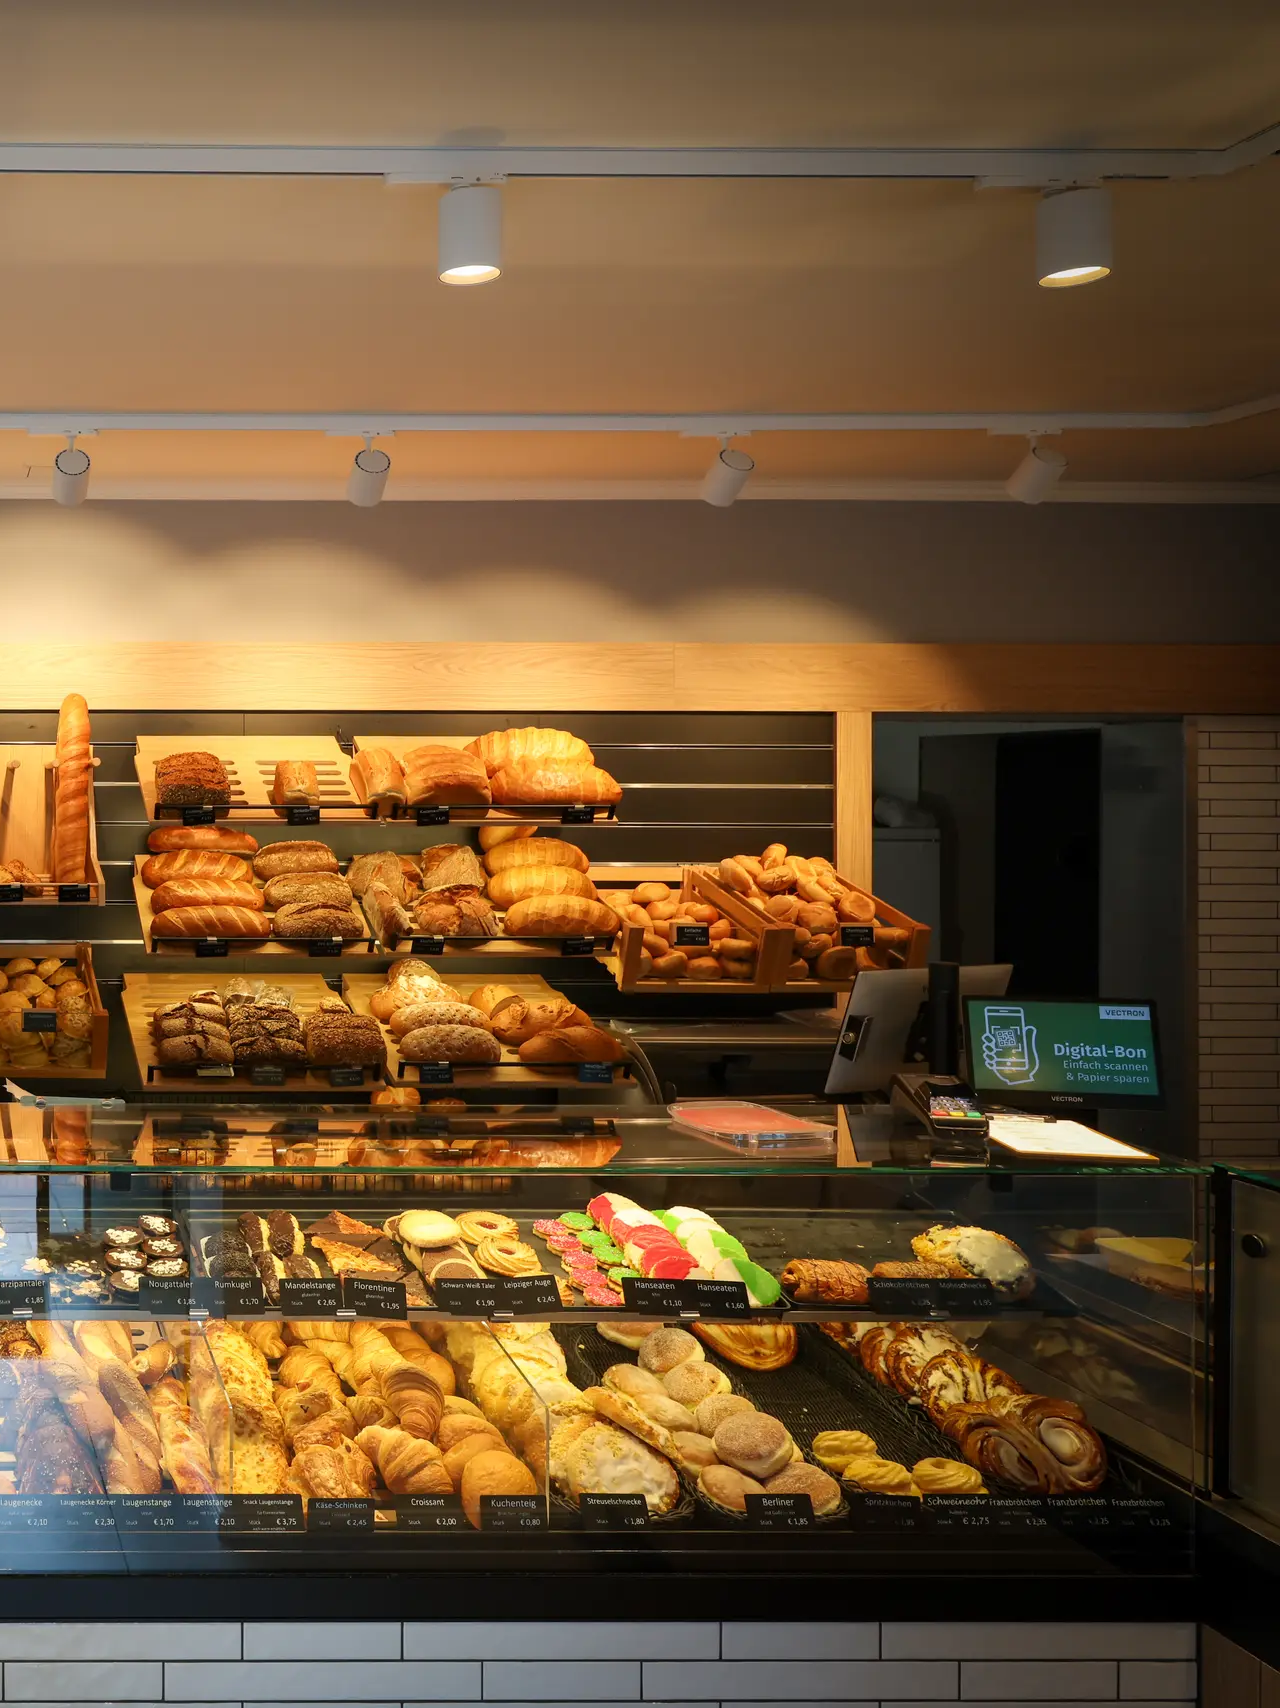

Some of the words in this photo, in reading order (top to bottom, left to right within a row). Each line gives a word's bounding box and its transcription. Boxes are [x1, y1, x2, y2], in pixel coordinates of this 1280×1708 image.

[1104, 1009, 1146, 1018] VECTRON
[1053, 1042, 1148, 1061] Digital-Bon
[1063, 1060, 1102, 1071] Einfach
[1103, 1062, 1149, 1072] scannen
[1065, 1072, 1075, 1082] &
[1077, 1072, 1112, 1085] Papier
[1113, 1075, 1150, 1086] sparen
[1051, 1095, 1084, 1103] VECTRON
[149, 1281, 193, 1289] Nougattaler
[214, 1281, 252, 1289] Rumkugel
[285, 1282, 336, 1290] Mandelstange
[353, 1282, 396, 1293] Florentiner
[503, 1281, 533, 1289] Leipziger
[534, 1279, 552, 1287] Auge
[634, 1281, 675, 1290] Hanseaten
[697, 1283, 737, 1292] Hanseaten
[322, 1299, 336, 1307] 2,65
[386, 1302, 400, 1310] 1,95
[731, 1302, 744, 1310] 1,60
[0, 1497, 43, 1507] Laugenecke
[96, 1498, 116, 1506] Körner
[122, 1498, 172, 1507] Laugenstange
[183, 1498, 233, 1507] Laugenstange
[315, 1501, 368, 1509] Käse-Schinken
[411, 1498, 444, 1506] Croissant
[491, 1499, 536, 1509] Kuchenteig
[763, 1498, 794, 1506] Berliner
[865, 1498, 912, 1508] Spritzkuchen
[927, 1497, 987, 1506] Schweineohr
[989, 1498, 1042, 1506] Franzbrötchen
[1047, 1498, 1107, 1506] Franzbrötchen
[1112, 1499, 1165, 1507] Franzbrötchen
[33, 1518, 48, 1526] 2,10
[100, 1518, 115, 1526] 2,30
[159, 1518, 174, 1526] 1,70
[220, 1518, 235, 1526] 2,10
[282, 1518, 297, 1526] 3,75
[352, 1519, 367, 1527] 2,45
[442, 1518, 457, 1526] 2,00
[526, 1518, 541, 1526] 0,80
[794, 1518, 808, 1526] 1,85
[971, 1517, 989, 1525] 2,75
